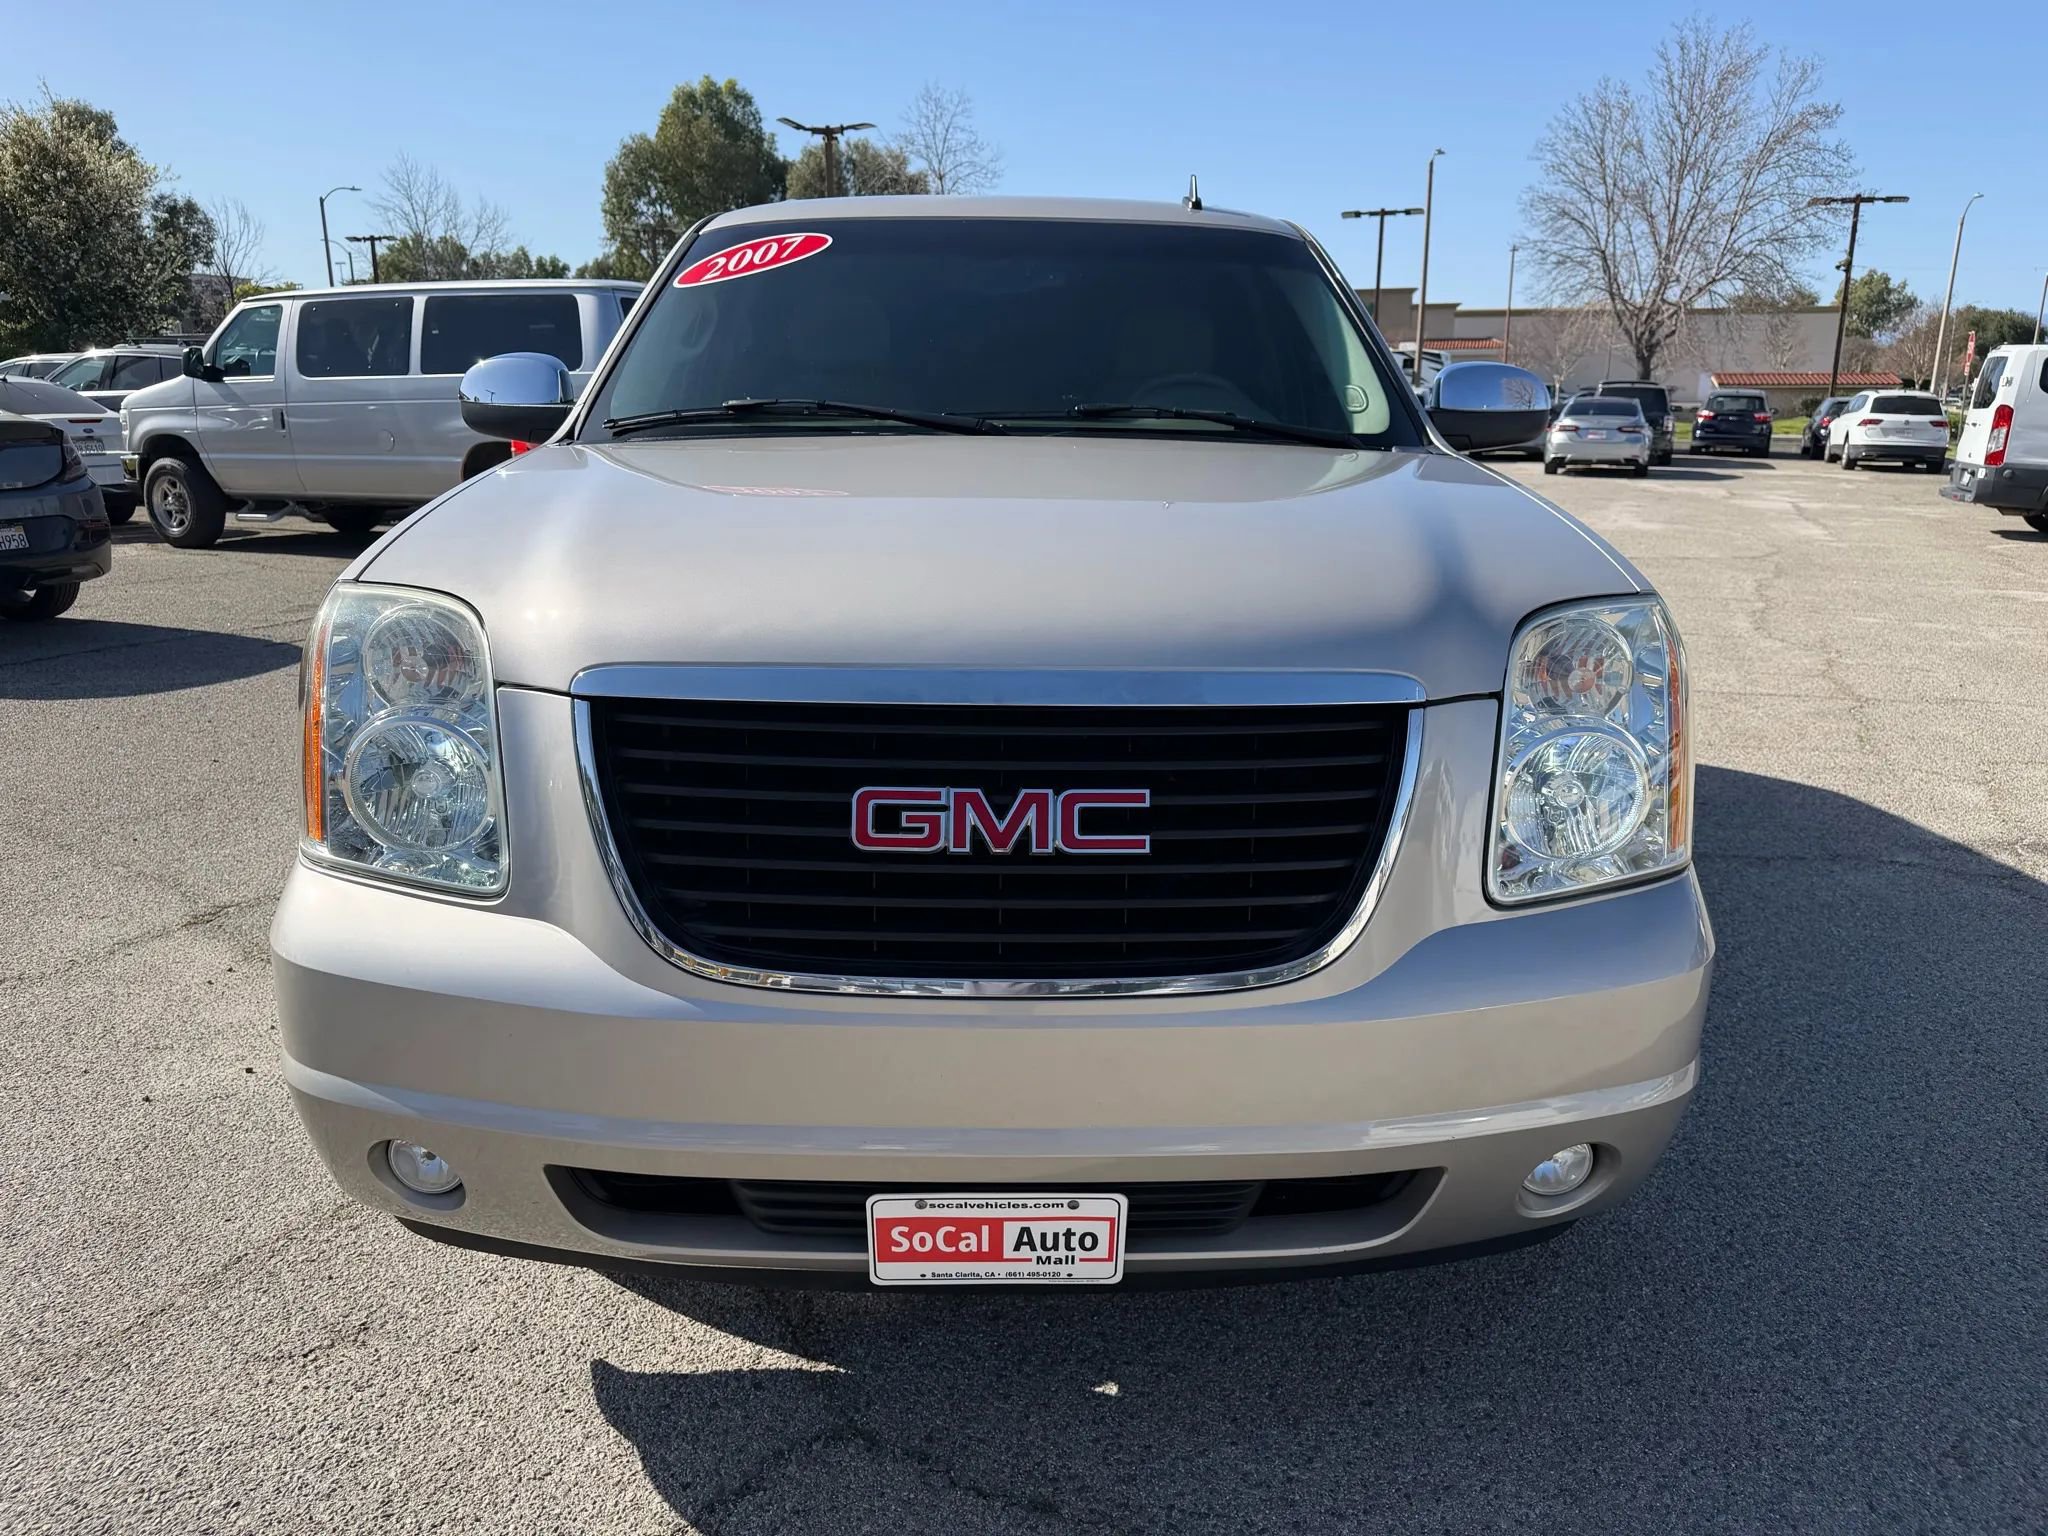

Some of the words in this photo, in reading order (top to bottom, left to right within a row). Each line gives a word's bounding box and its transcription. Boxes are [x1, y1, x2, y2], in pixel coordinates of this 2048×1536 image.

[700, 235, 806, 282] 2007
[850, 786, 1151, 855] GMC
[928, 1201, 1064, 1209] socalvehicles.com
[890, 1225, 990, 1253] SoCal
[1012, 1226, 1099, 1252] Auto
[1036, 1255, 1076, 1265] Mall
